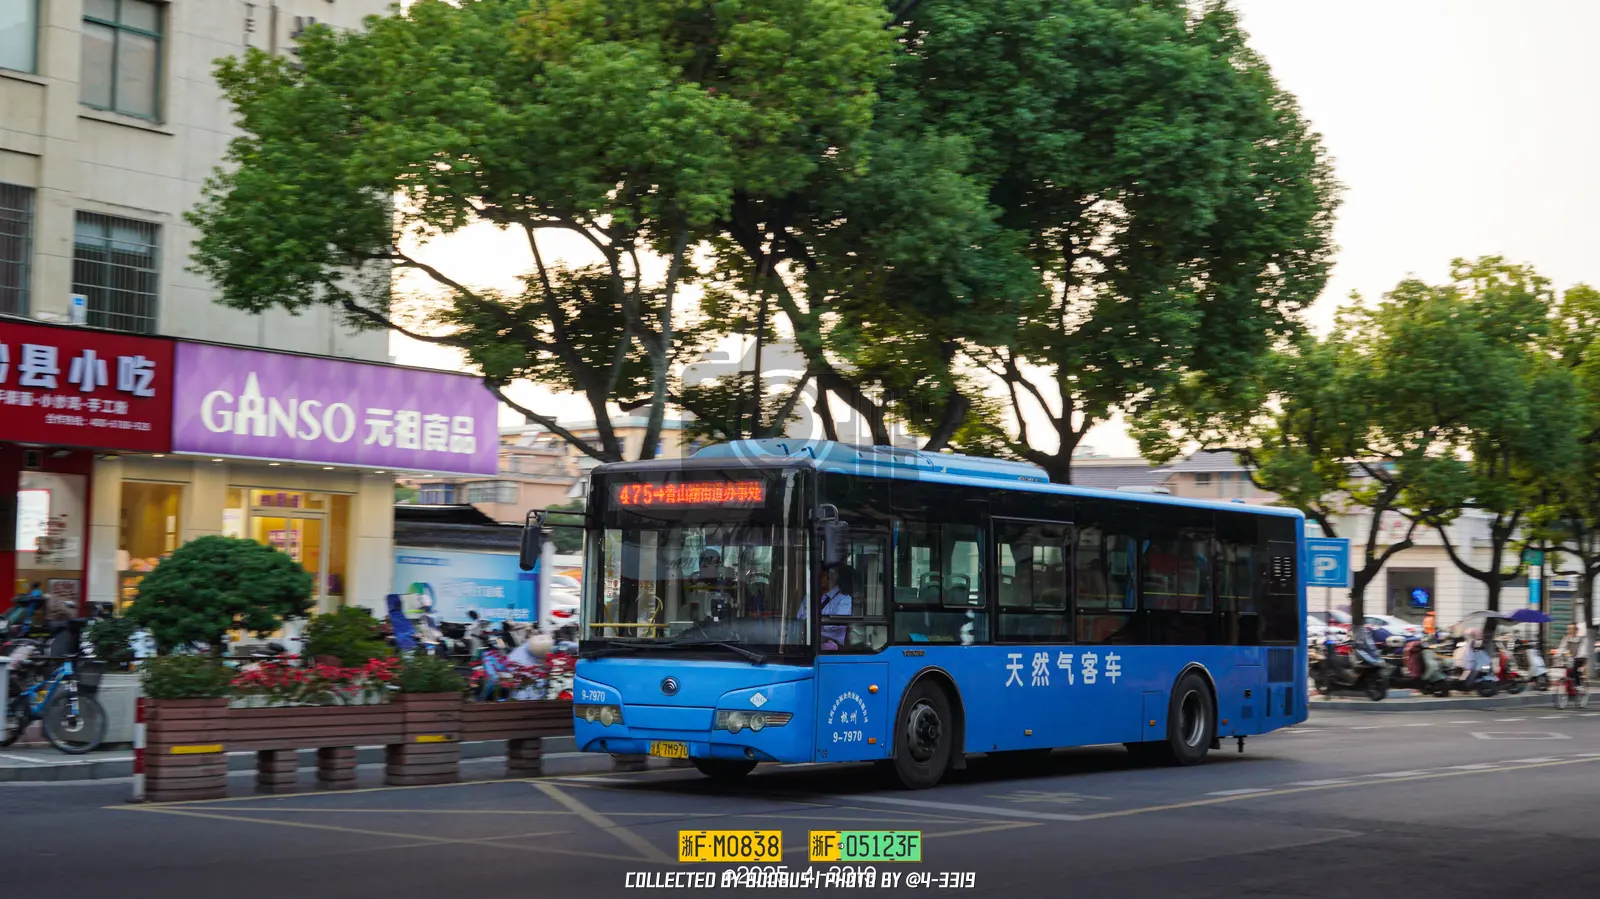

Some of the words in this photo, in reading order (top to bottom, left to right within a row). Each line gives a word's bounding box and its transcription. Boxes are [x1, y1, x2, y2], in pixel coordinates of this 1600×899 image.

[200, 371, 356, 443] GANSO
[363, 407, 477, 455] 元祖食品
[619, 483, 653, 505] 475
[1005, 651, 1122, 687] 天然气客车
[581, 690, 606, 702] 9-7970
[832, 730, 863, 743] 9-7970
